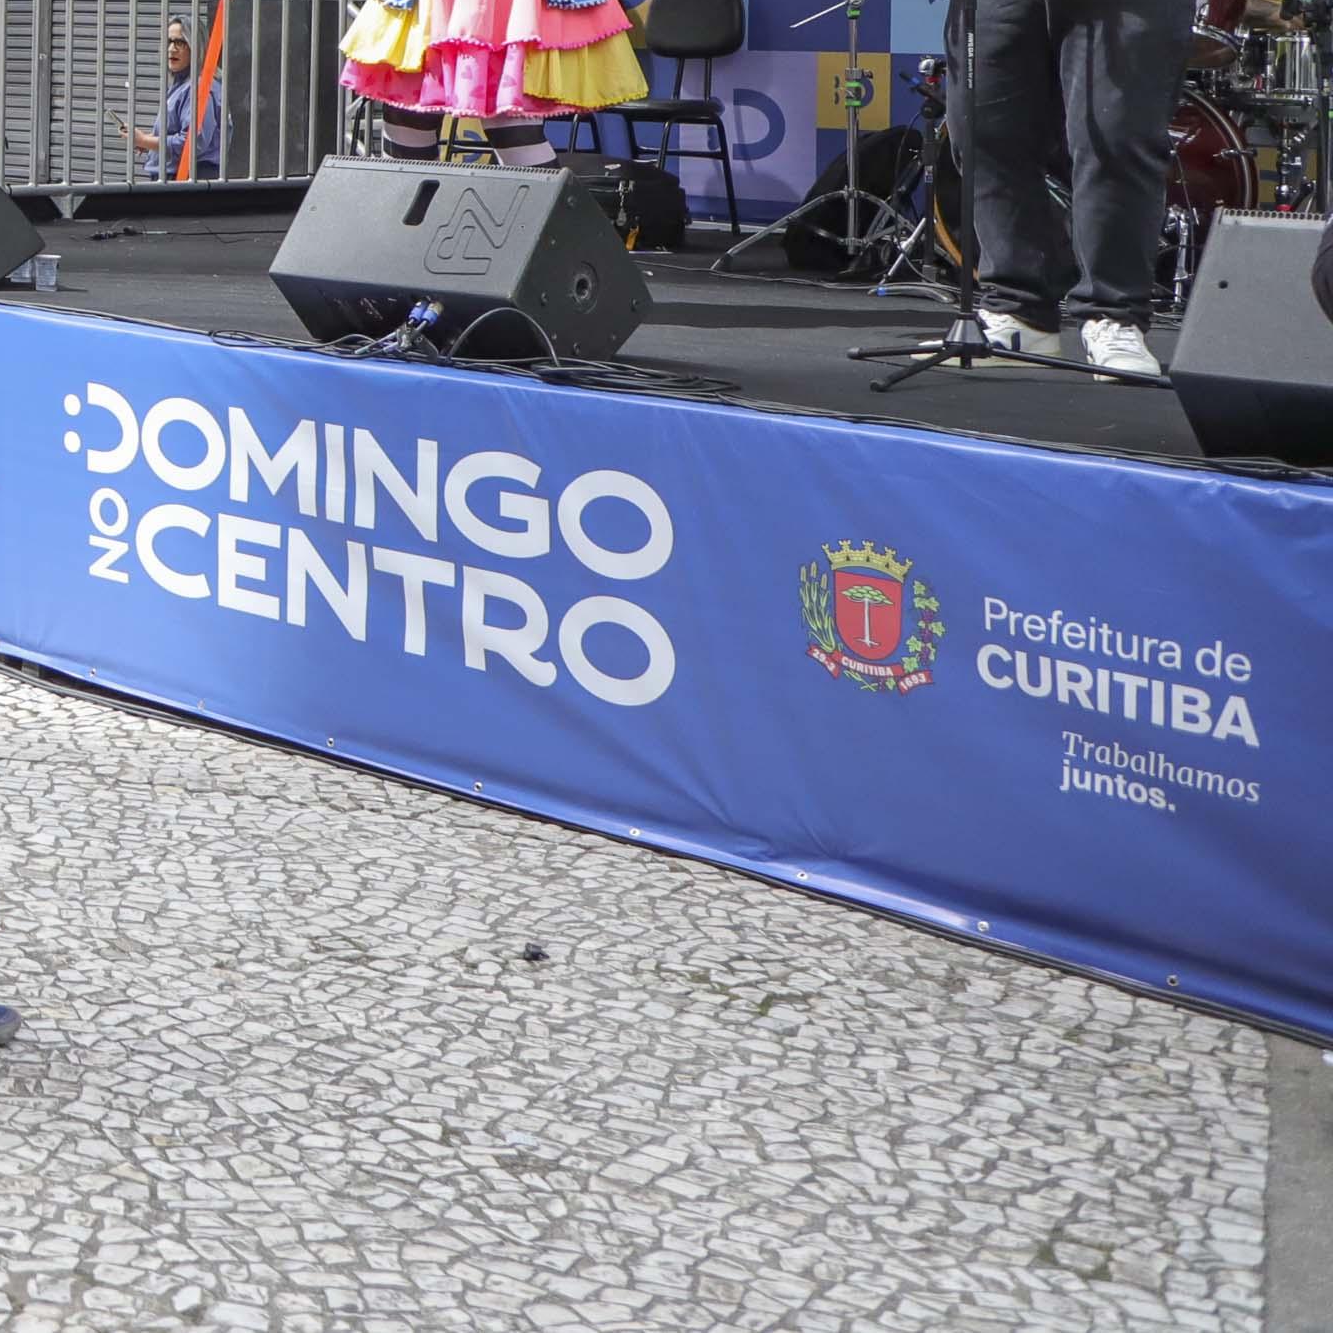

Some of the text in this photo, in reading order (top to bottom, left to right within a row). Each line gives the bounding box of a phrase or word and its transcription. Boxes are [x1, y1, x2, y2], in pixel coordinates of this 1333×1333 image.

[88, 487, 130, 584] NO
[134, 503, 676, 707] CENTRO
[983, 596, 1252, 683] Prefeitura de
[841, 656, 894, 677] CURITIBA
[899, 673, 927, 691] 1693
[976, 643, 1260, 748] CURITIBA
[1059, 759, 1176, 813] juntos.
[1061, 730, 1261, 804] Trabalhamos
